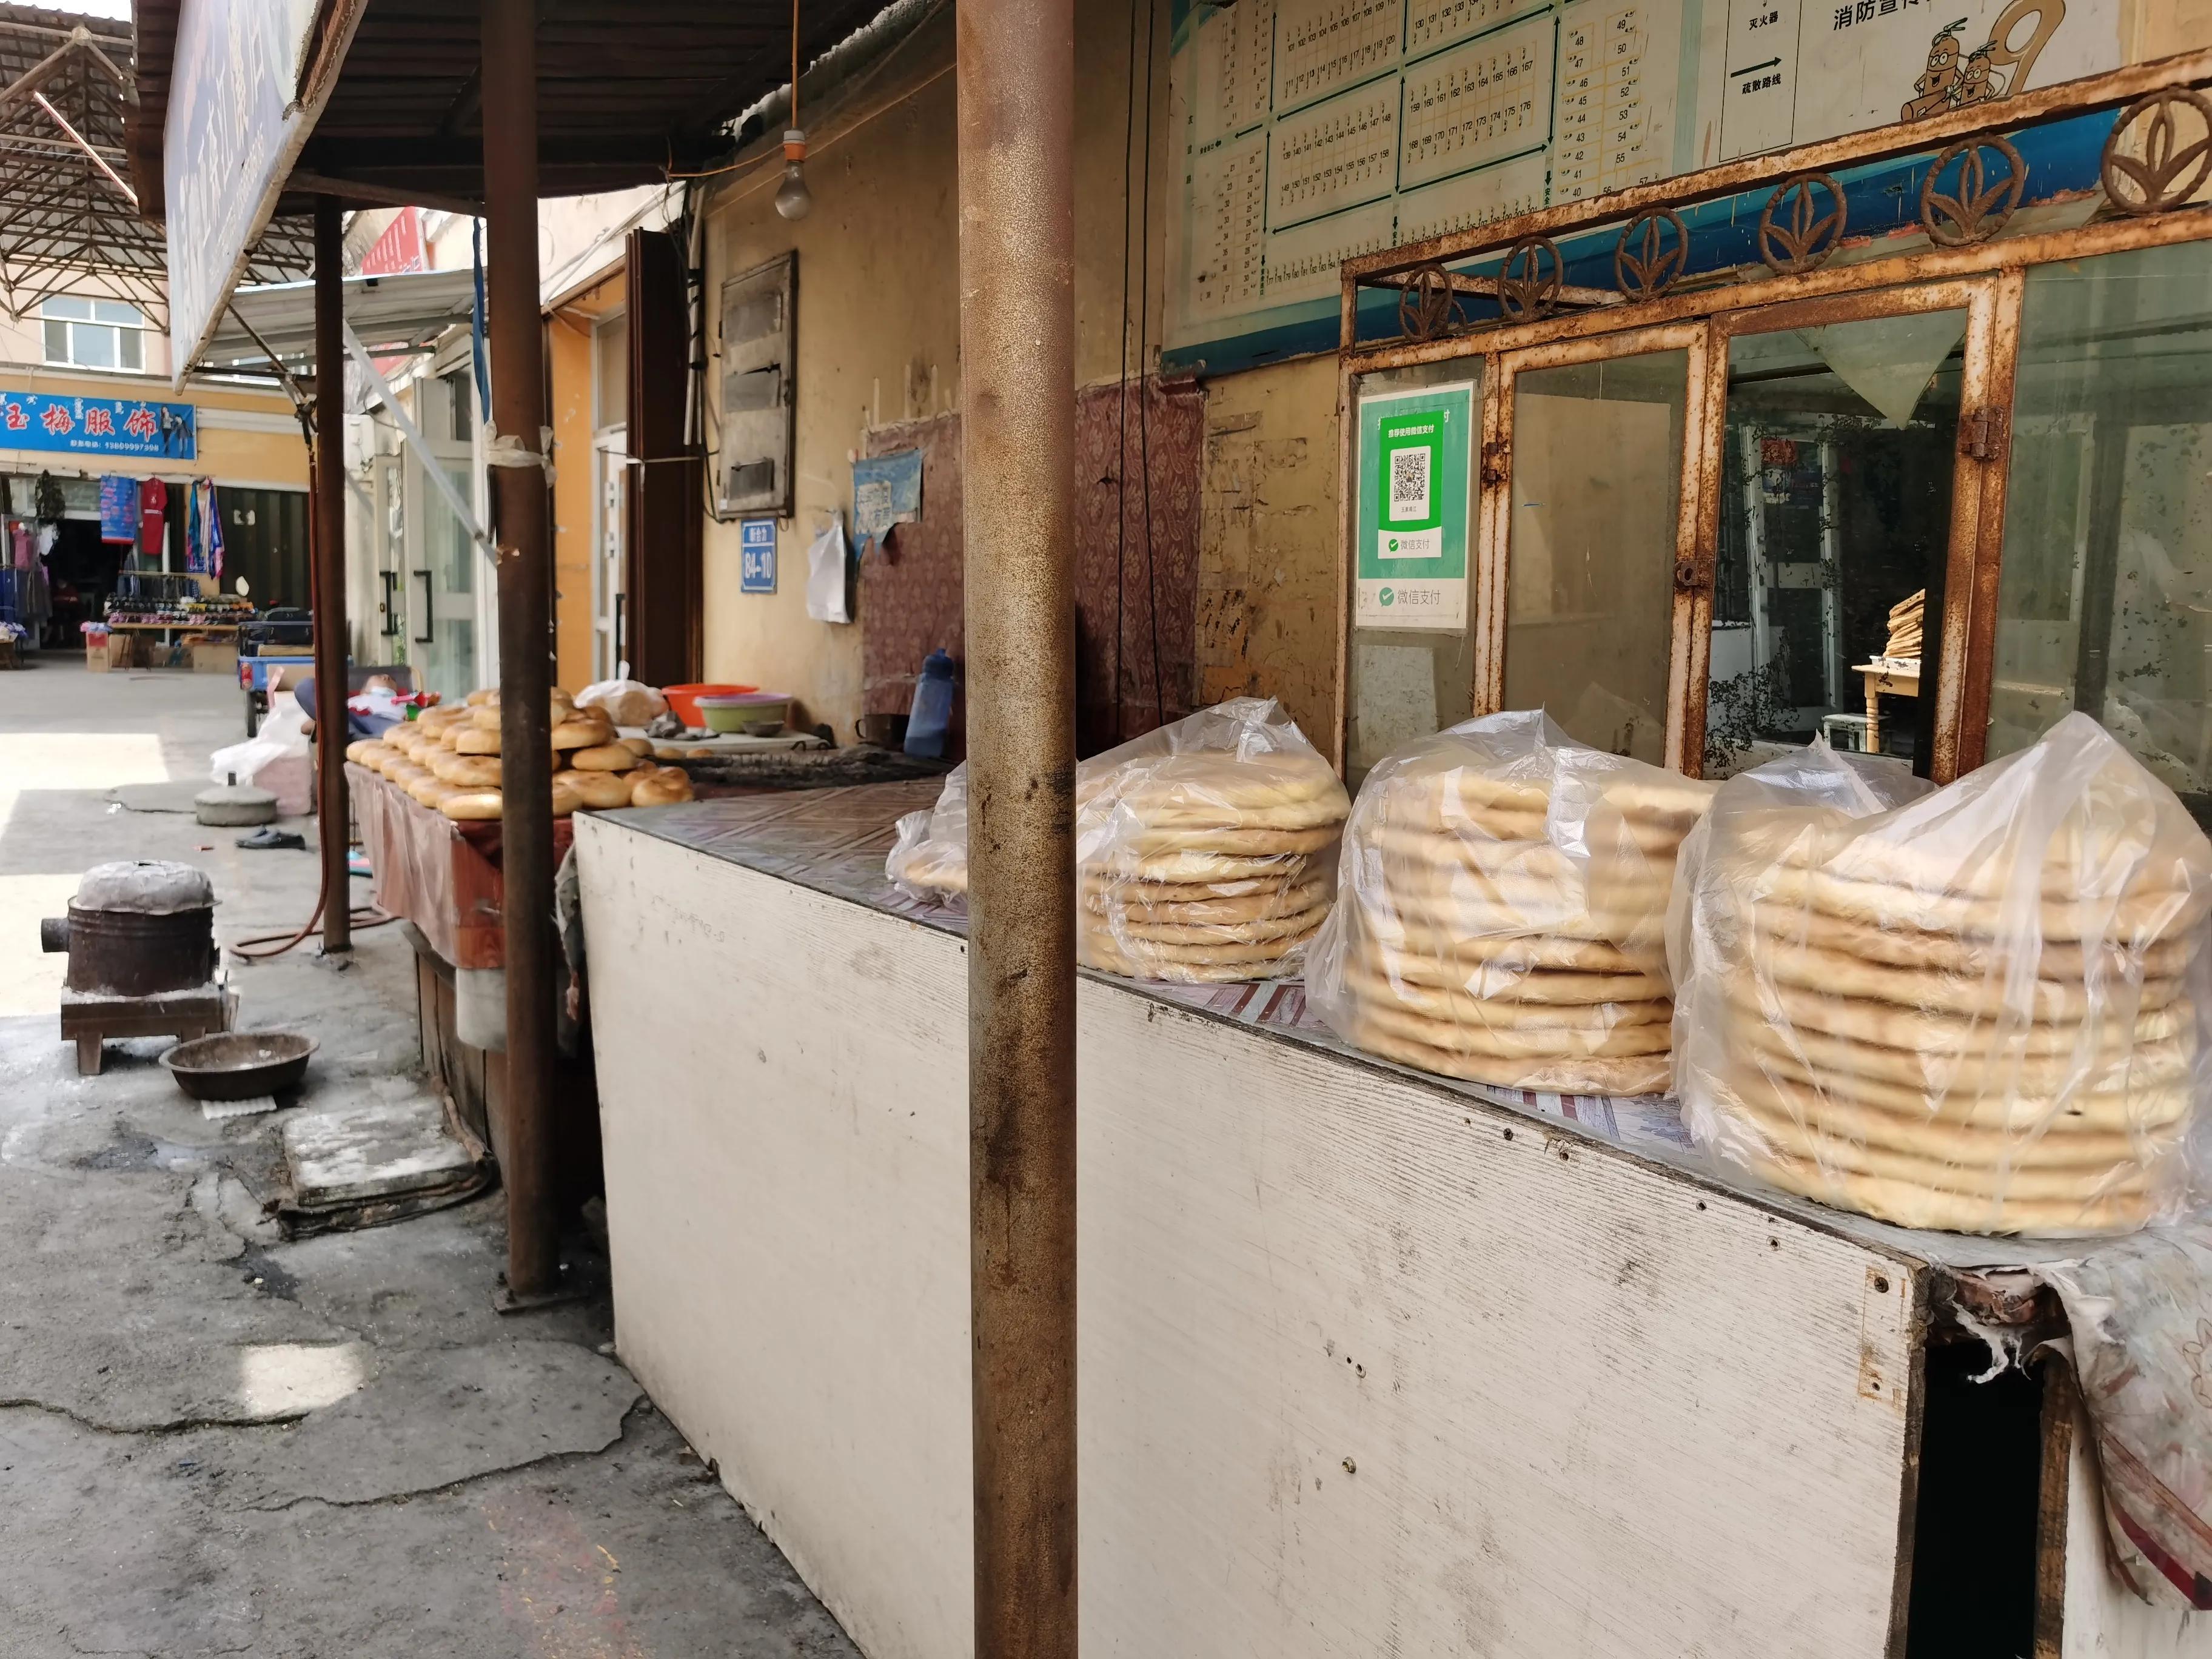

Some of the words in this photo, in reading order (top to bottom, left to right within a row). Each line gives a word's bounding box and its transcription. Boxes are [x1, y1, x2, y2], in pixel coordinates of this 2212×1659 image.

[1341, 18, 1349, 27] 106
[1352, 12, 1361, 22] 107
[1375, 2, 1384, 12] 109
[1415, 19, 1424, 30] 130
[1428, 13, 1436, 24] 131
[1442, 7, 1451, 18] 132
[1455, 2, 1464, 12] 133
[1617, 20, 1626, 29] 49
[1749, 10, 1778, 30] 灭火器
[1575, 36, 1584, 47] 48
[1618, 44, 1626, 53] 50
[1575, 58, 1583, 69] 47
[1621, 66, 1630, 76] 51
[1410, 103, 1419, 113] 159
[1424, 98, 1433, 108] 160
[1437, 93, 1446, 103] 161
[1450, 87, 1460, 98] 162
[1464, 82, 1474, 93] 163
[1478, 77, 1488, 88] 164
[1493, 72, 1503, 82] 165
[1507, 66, 1517, 78] 166
[1522, 60, 1533, 72] 167
[1579, 78, 1588, 88] 46
[1742, 73, 1781, 95] 疏散路线
[1620, 87, 1629, 97] 52
[1578, 96, 1587, 106] 45
[1577, 114, 1586, 123] 44
[1619, 110, 1627, 120] 53
[1347, 127, 1356, 136] 145
[1370, 118, 1379, 128] 147
[1382, 114, 1391, 124] 148
[1409, 140, 1418, 150] 168
[1422, 135, 1431, 146] 169
[1435, 130, 1444, 141] 170
[1448, 126, 1458, 136] 171
[1462, 121, 1472, 131] 172
[1476, 116, 1486, 127] 173
[1490, 111, 1501, 122] 174
[1504, 106, 1515, 117] 175
[1520, 101, 1530, 112] 176
[1577, 132, 1584, 142] 43
[1618, 132, 1626, 142] 54
[1357, 158, 1366, 166] 156
[1369, 153, 1377, 163] 157
[1575, 152, 1584, 161] 42
[1616, 153, 1625, 163] 55
[1574, 170, 1581, 179] 41
[1640, 176, 1649, 185] 57
[1573, 187, 1581, 197] 40
[7, 403, 159, 443] 玉梅服饰
[1388, 424, 1435, 438] 推荐使用微信支付
[1400, 538, 1430, 550] 微信支付
[1397, 589, 1441, 605] 微信支付
